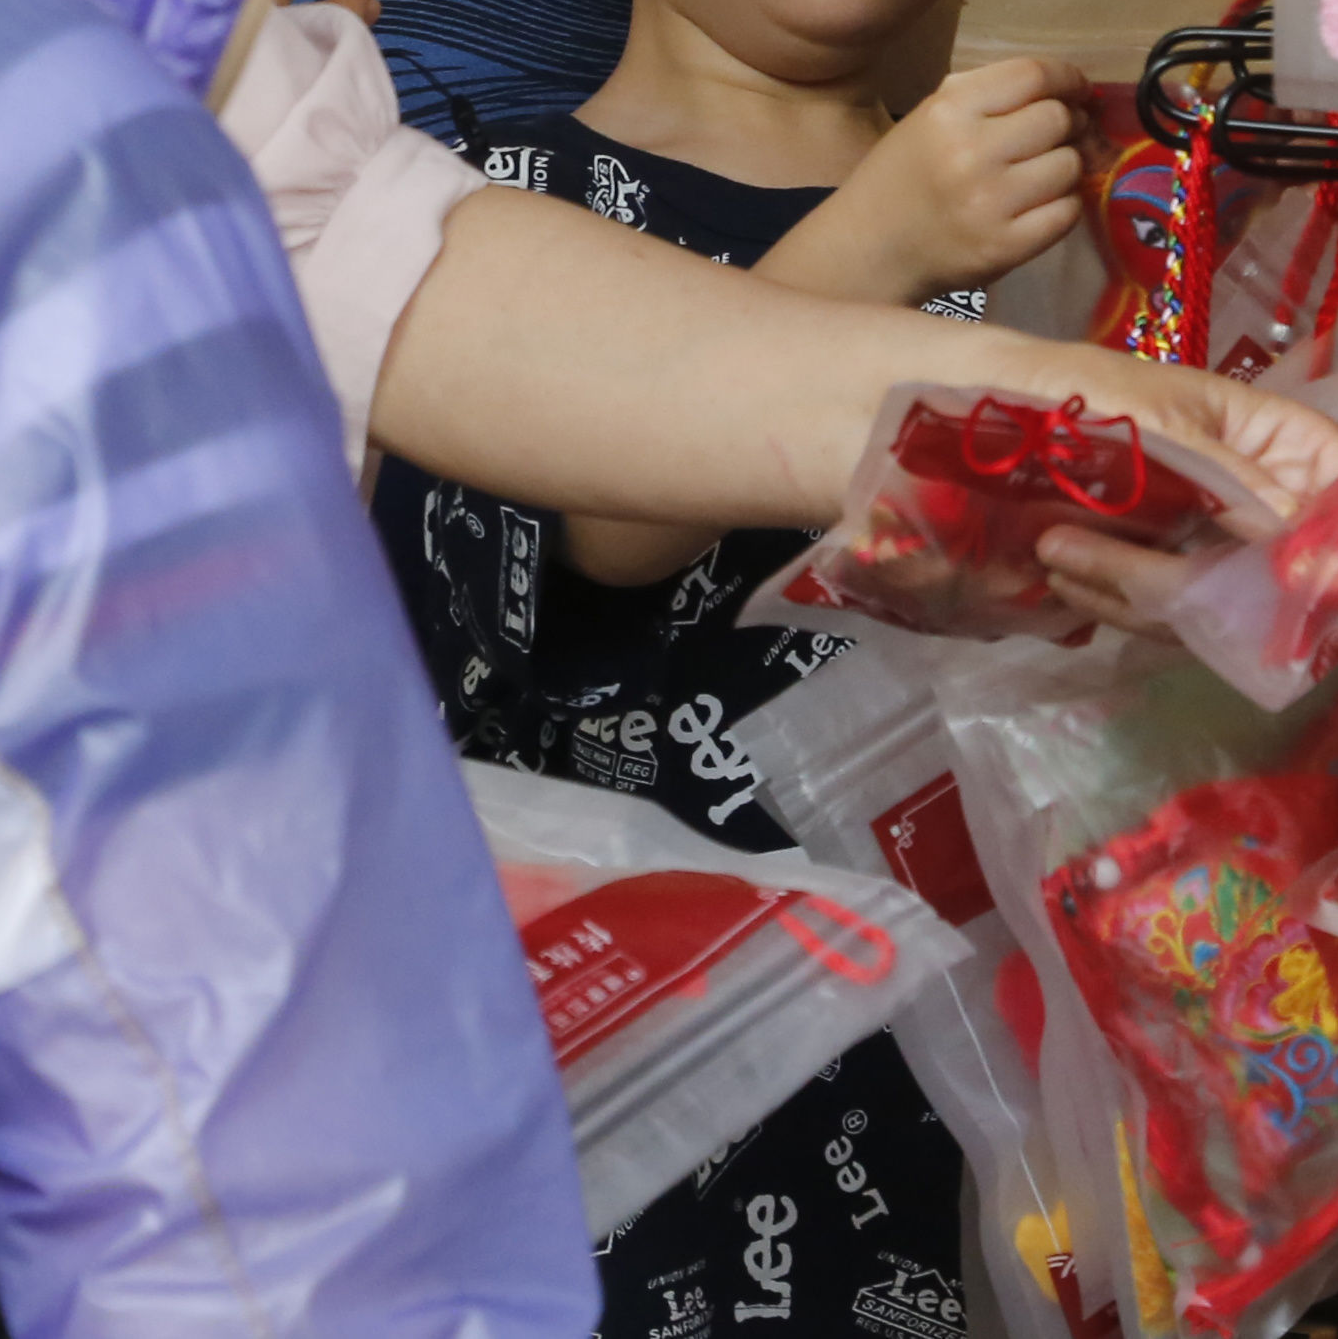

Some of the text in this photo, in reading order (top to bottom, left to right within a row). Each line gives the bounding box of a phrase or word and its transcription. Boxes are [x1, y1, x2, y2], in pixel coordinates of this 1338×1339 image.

[622, 761, 650, 778] REG
[734, 1193, 799, 1323] Lee
[876, 1250, 923, 1274] UNION
[662, 1286, 708, 1321] Lee
[887, 1268, 962, 1322] Lee
[861, 1299, 967, 1339] SANFORIZE
